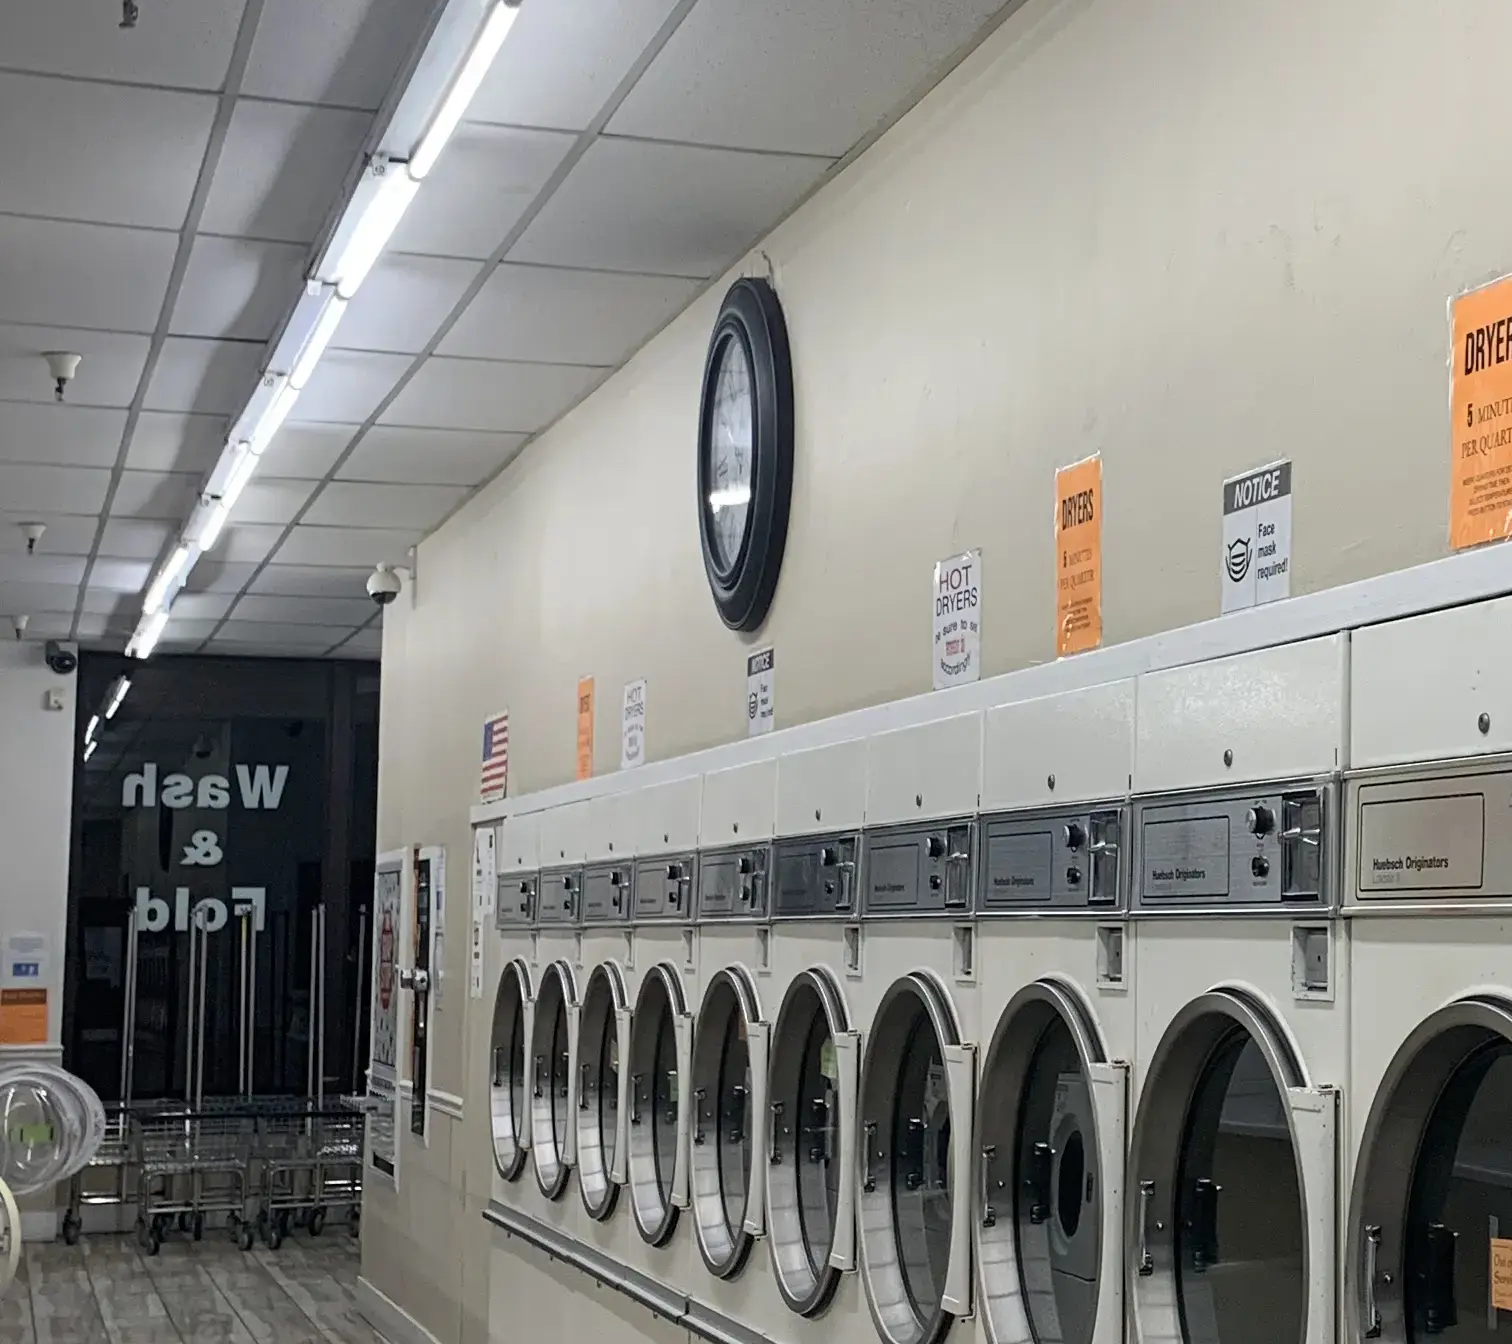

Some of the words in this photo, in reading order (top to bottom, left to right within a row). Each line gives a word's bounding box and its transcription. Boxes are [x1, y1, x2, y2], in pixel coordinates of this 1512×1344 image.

[1467, 403, 1473, 428] 5
[1461, 439, 1478, 459] PER
[1234, 469, 1281, 508] NOTICE
[1062, 487, 1094, 531] DRYERS
[1258, 523, 1275, 538] Face
[1257, 540, 1277, 558] mask
[939, 564, 972, 594] HOT
[1257, 557, 1288, 580] required!
[936, 587, 978, 617] DRYERS
[942, 621, 958, 636] sure
[1373, 857, 1403, 871] Huebsch
[1405, 855, 1449, 872] Originators
